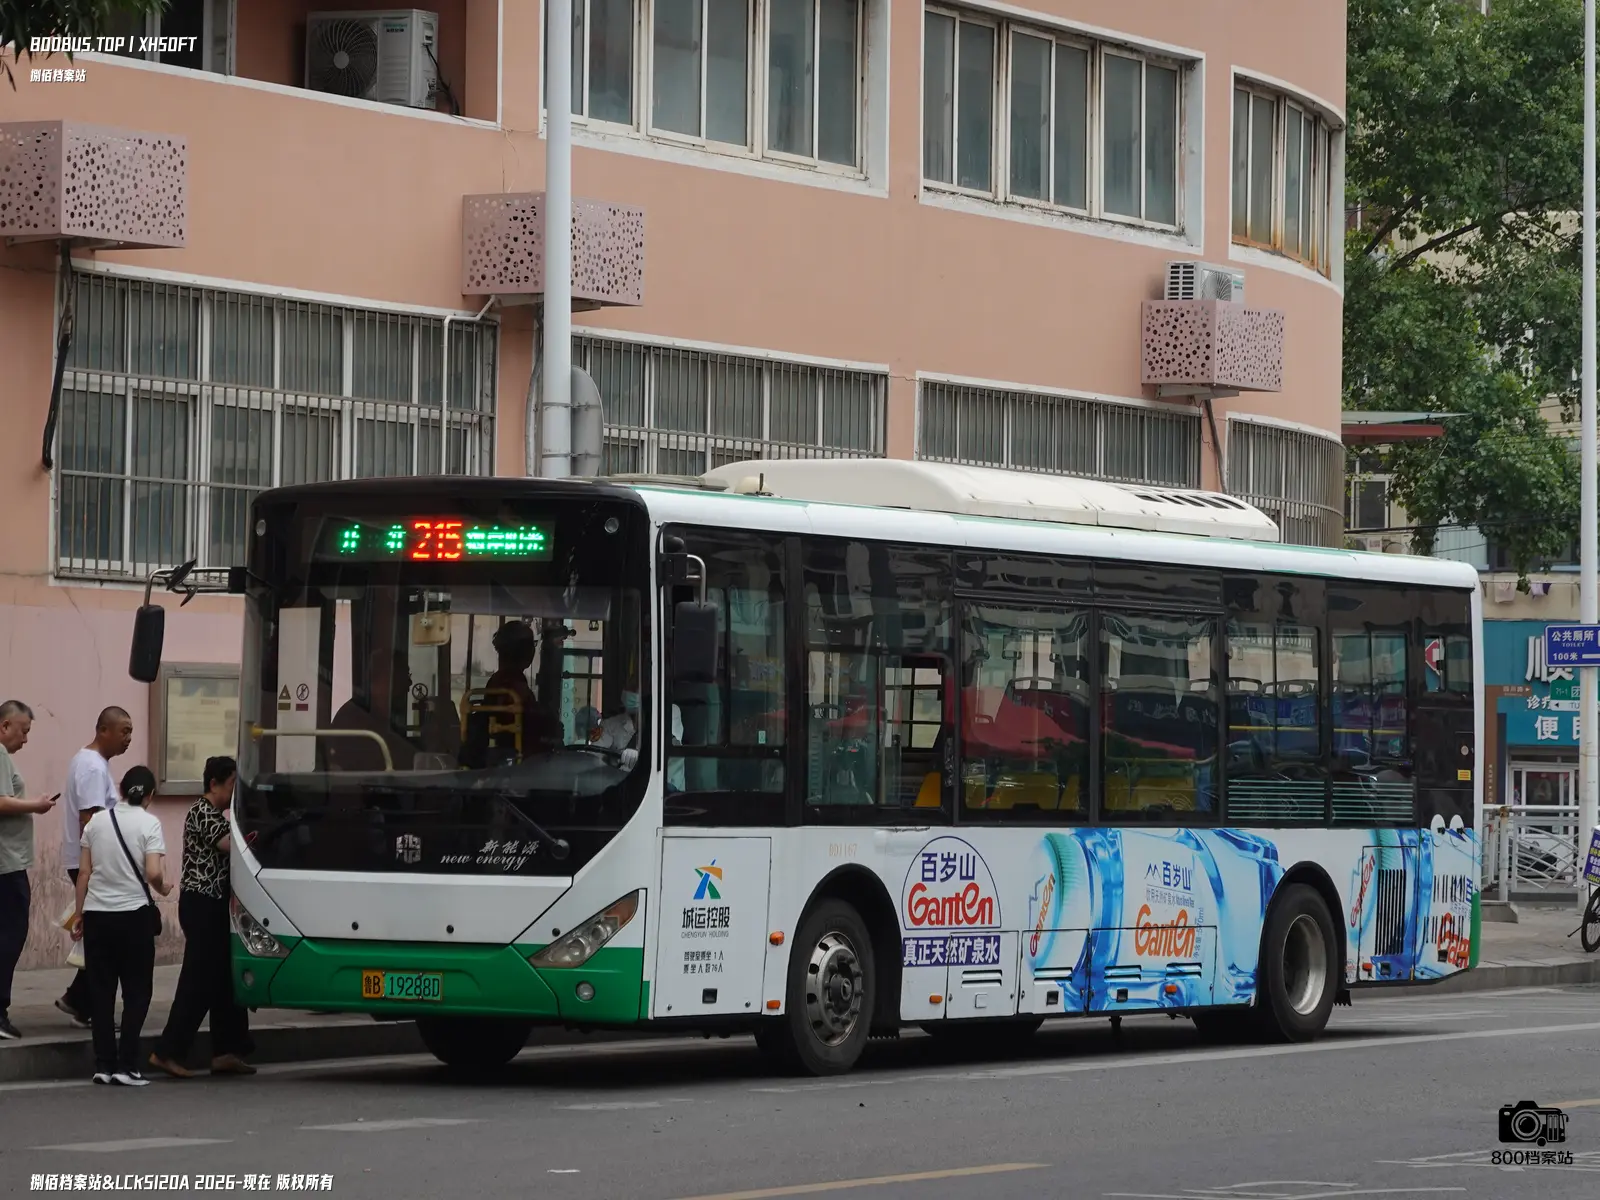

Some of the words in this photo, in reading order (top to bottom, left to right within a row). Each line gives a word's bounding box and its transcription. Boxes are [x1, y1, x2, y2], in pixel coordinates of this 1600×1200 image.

[1551, 630, 1594, 642] 公共厕所
[1553, 652, 1578, 661] 100米
[440, 854, 472, 864] new
[476, 853, 530, 871] energy
[921, 852, 976, 883] 百岁山
[1162, 861, 1191, 891] 百岁山
[908, 882, 993, 926] Ganten
[682, 907, 730, 929] 城运控股
[1135, 903, 1195, 958] Ganten
[681, 931, 707, 939] CHENGYUN
[903, 938, 999, 967] 真正天然矿泉水
